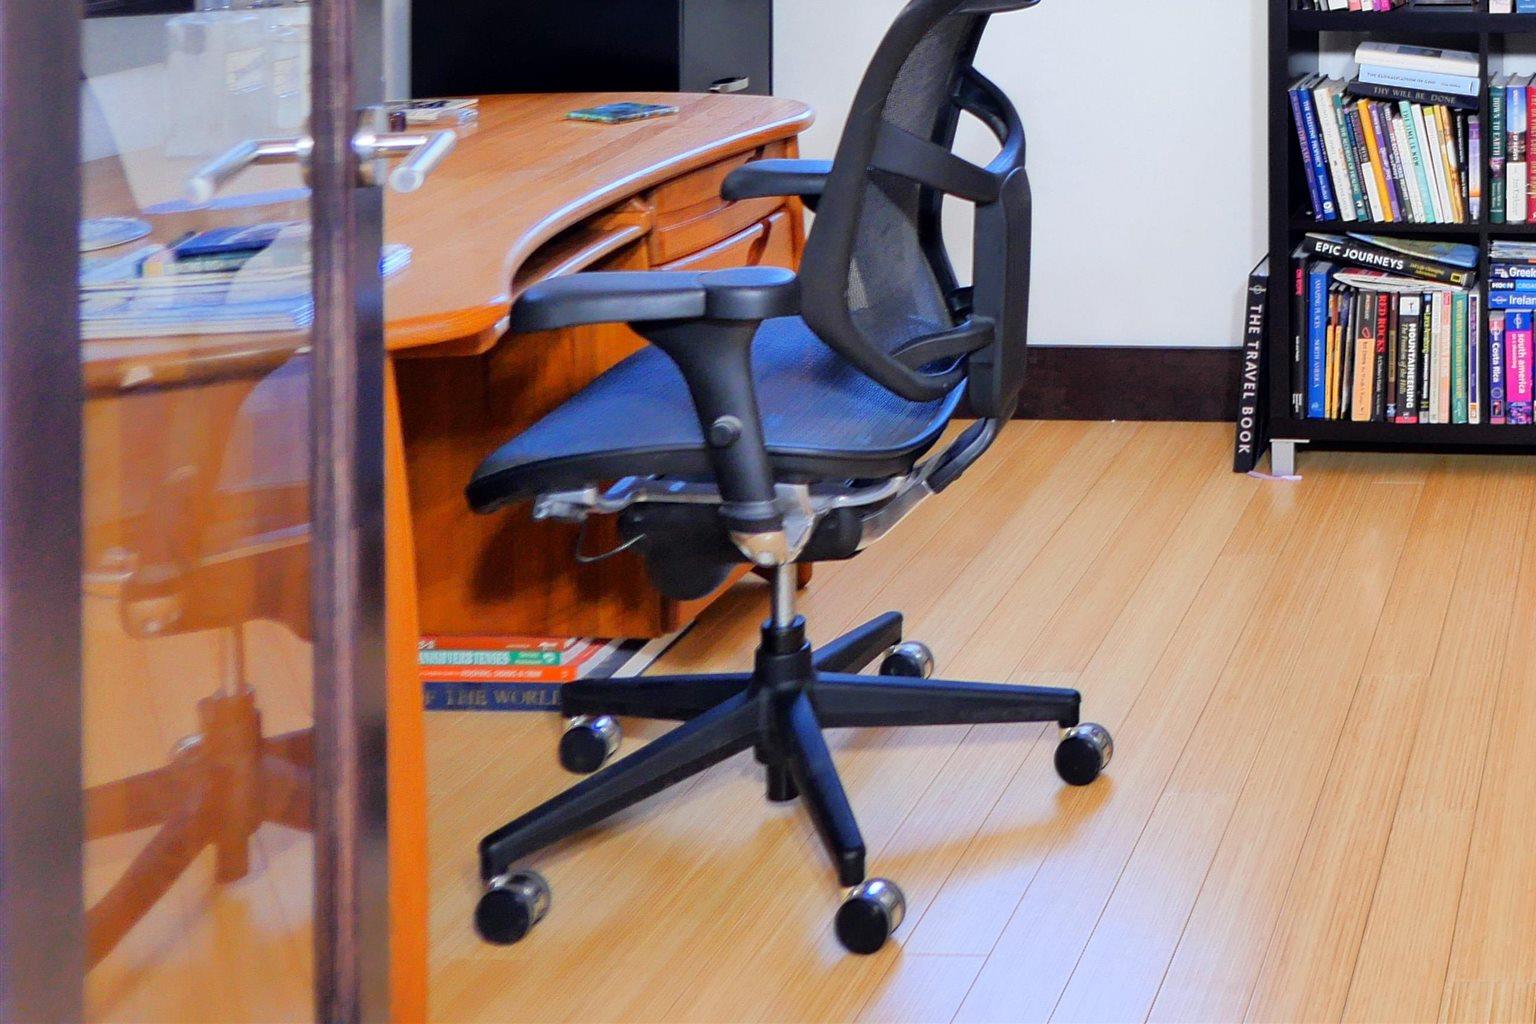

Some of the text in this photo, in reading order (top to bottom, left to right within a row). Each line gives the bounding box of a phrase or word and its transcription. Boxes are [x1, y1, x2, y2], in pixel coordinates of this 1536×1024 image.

[1373, 87, 1389, 95] THY
[1392, 89, 1411, 98] WILL
[1431, 95, 1456, 104] DONE
[1405, 124, 1413, 140] TIME
[1493, 97, 1501, 157] DOWN TO EARTH
[1408, 142, 1415, 150] IS
[1411, 151, 1419, 167] NOW
[1315, 241, 1404, 270] EPIC JOURNEYS
[1509, 268, 1536, 280] Greek
[1377, 295, 1386, 352] RED ROCKS
[1406, 323, 1416, 408] MOUNTAINEERING
[1238, 304, 1262, 454] THE TRAVEL BOOK
[447, 690, 487, 705] THE
